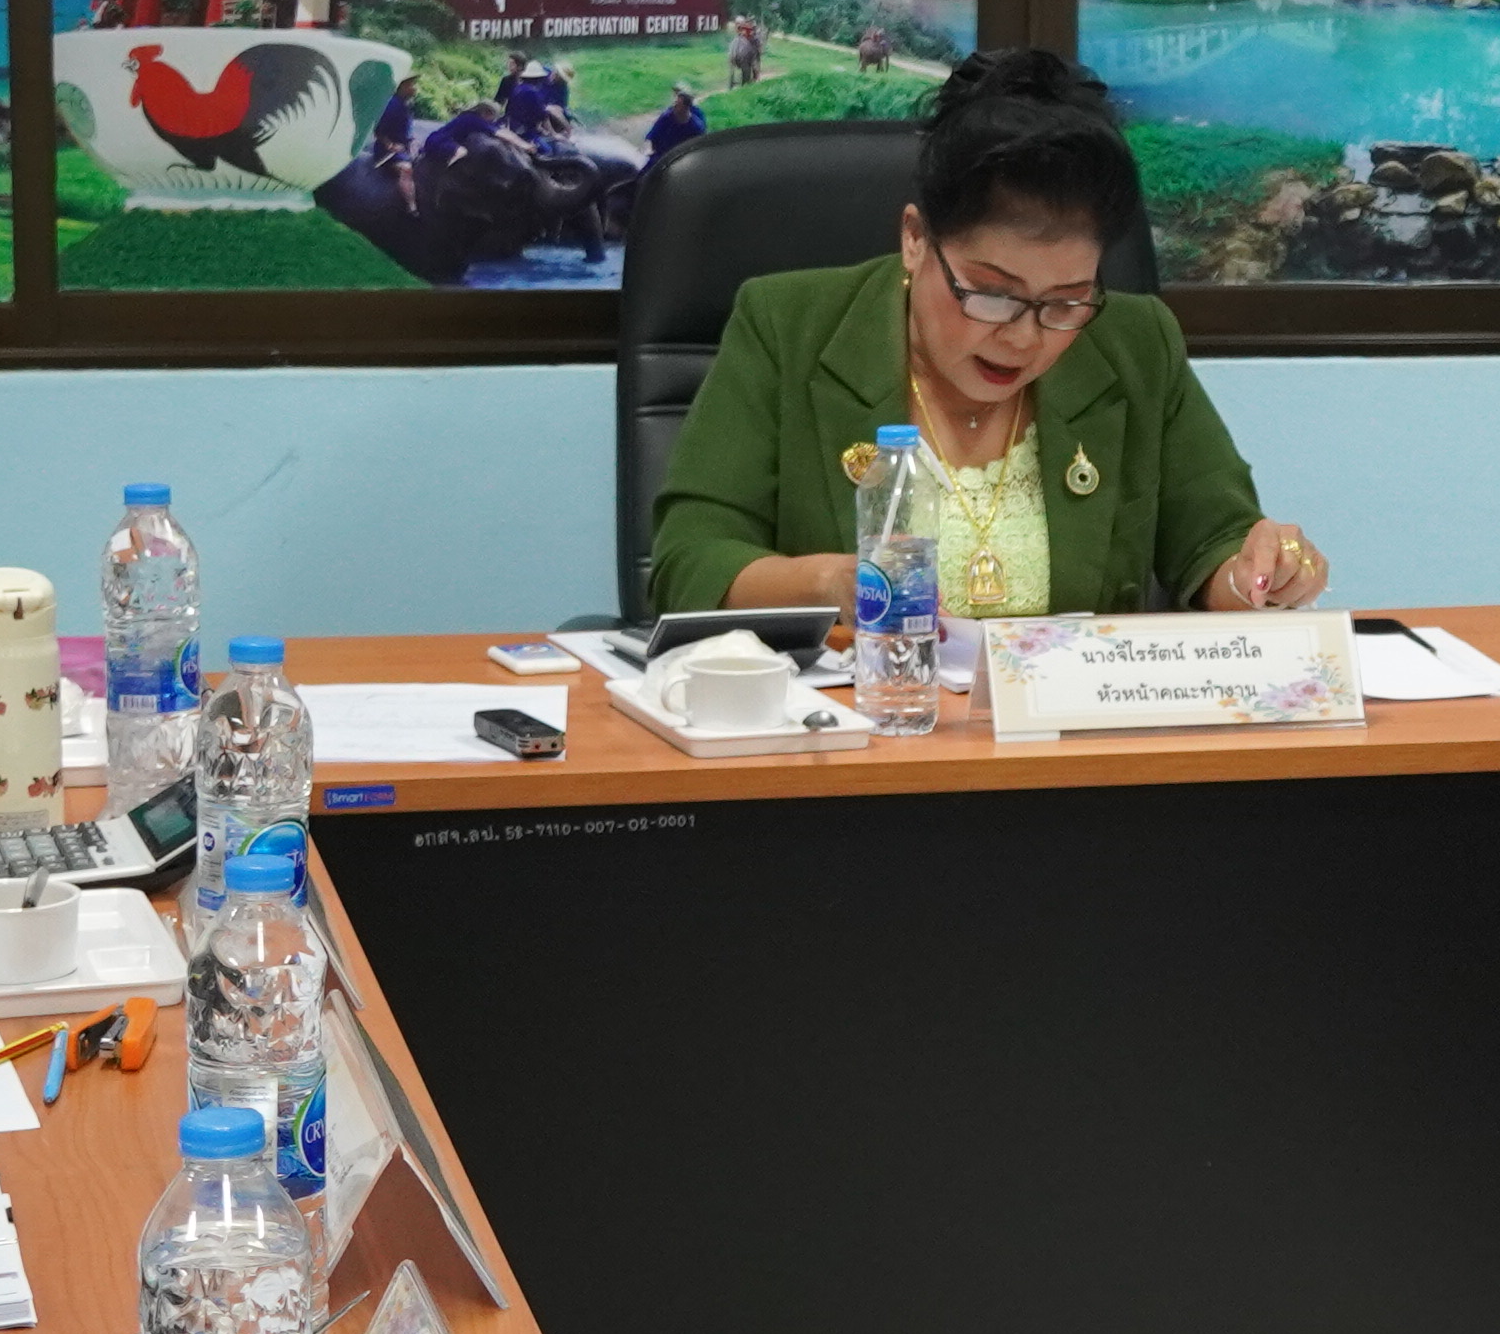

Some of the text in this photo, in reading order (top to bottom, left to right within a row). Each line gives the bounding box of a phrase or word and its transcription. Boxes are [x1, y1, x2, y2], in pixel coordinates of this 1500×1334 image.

[461, 18, 535, 41] EPHANT
[543, 15, 640, 38] CONSERVATION
[645, 14, 690, 34] CENTER
[1097, 679, 1258, 703] หัวหน้าคณะทำงาน
